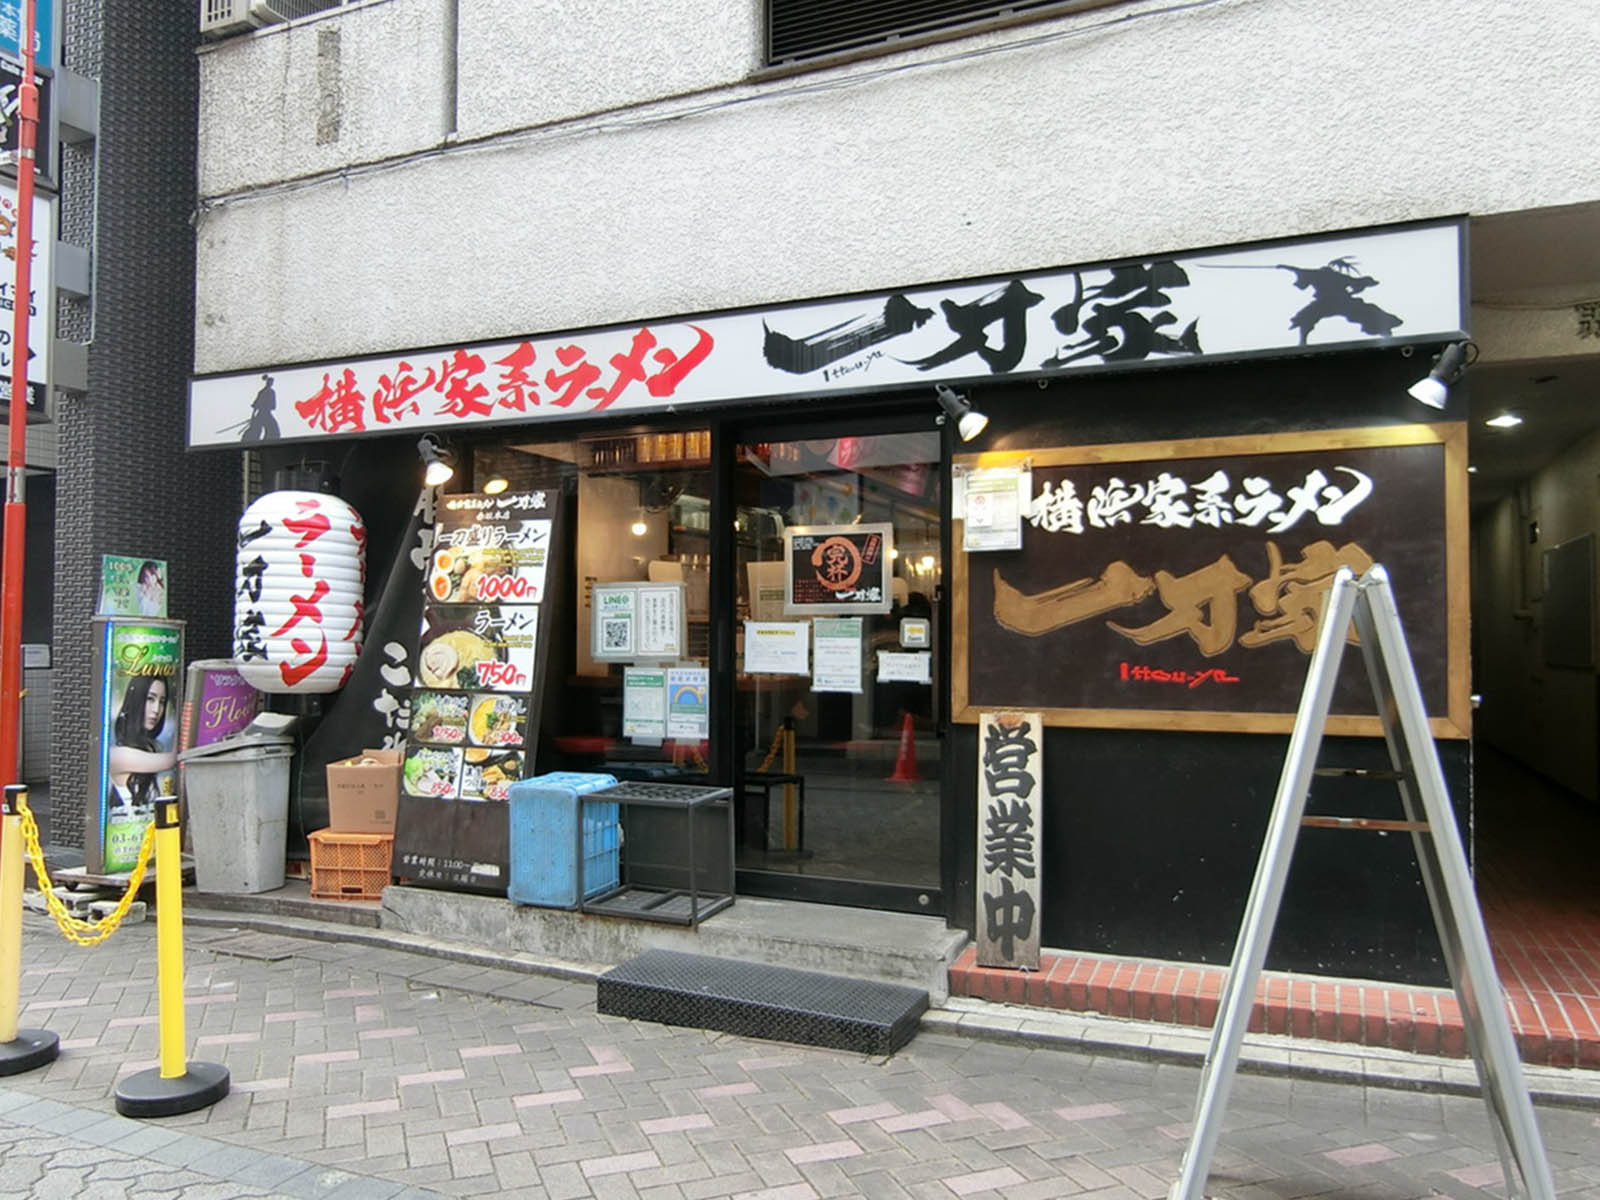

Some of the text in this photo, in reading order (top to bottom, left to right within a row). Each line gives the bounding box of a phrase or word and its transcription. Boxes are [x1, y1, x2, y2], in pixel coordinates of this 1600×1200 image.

[763, 260, 1203, 374] 一刀家
[295, 324, 715, 433] 横浜家系ラーメン
[1026, 466, 1373, 534] 横浜家系ラーメン
[440, 526, 547, 547] 一刀盛りラーメン
[270, 499, 332, 687] ラーメン
[477, 576, 537, 598] 1000円
[475, 611, 534, 632] ラーメン
[477, 660, 527, 686] 750円
[982, 720, 1038, 961] 営業中
